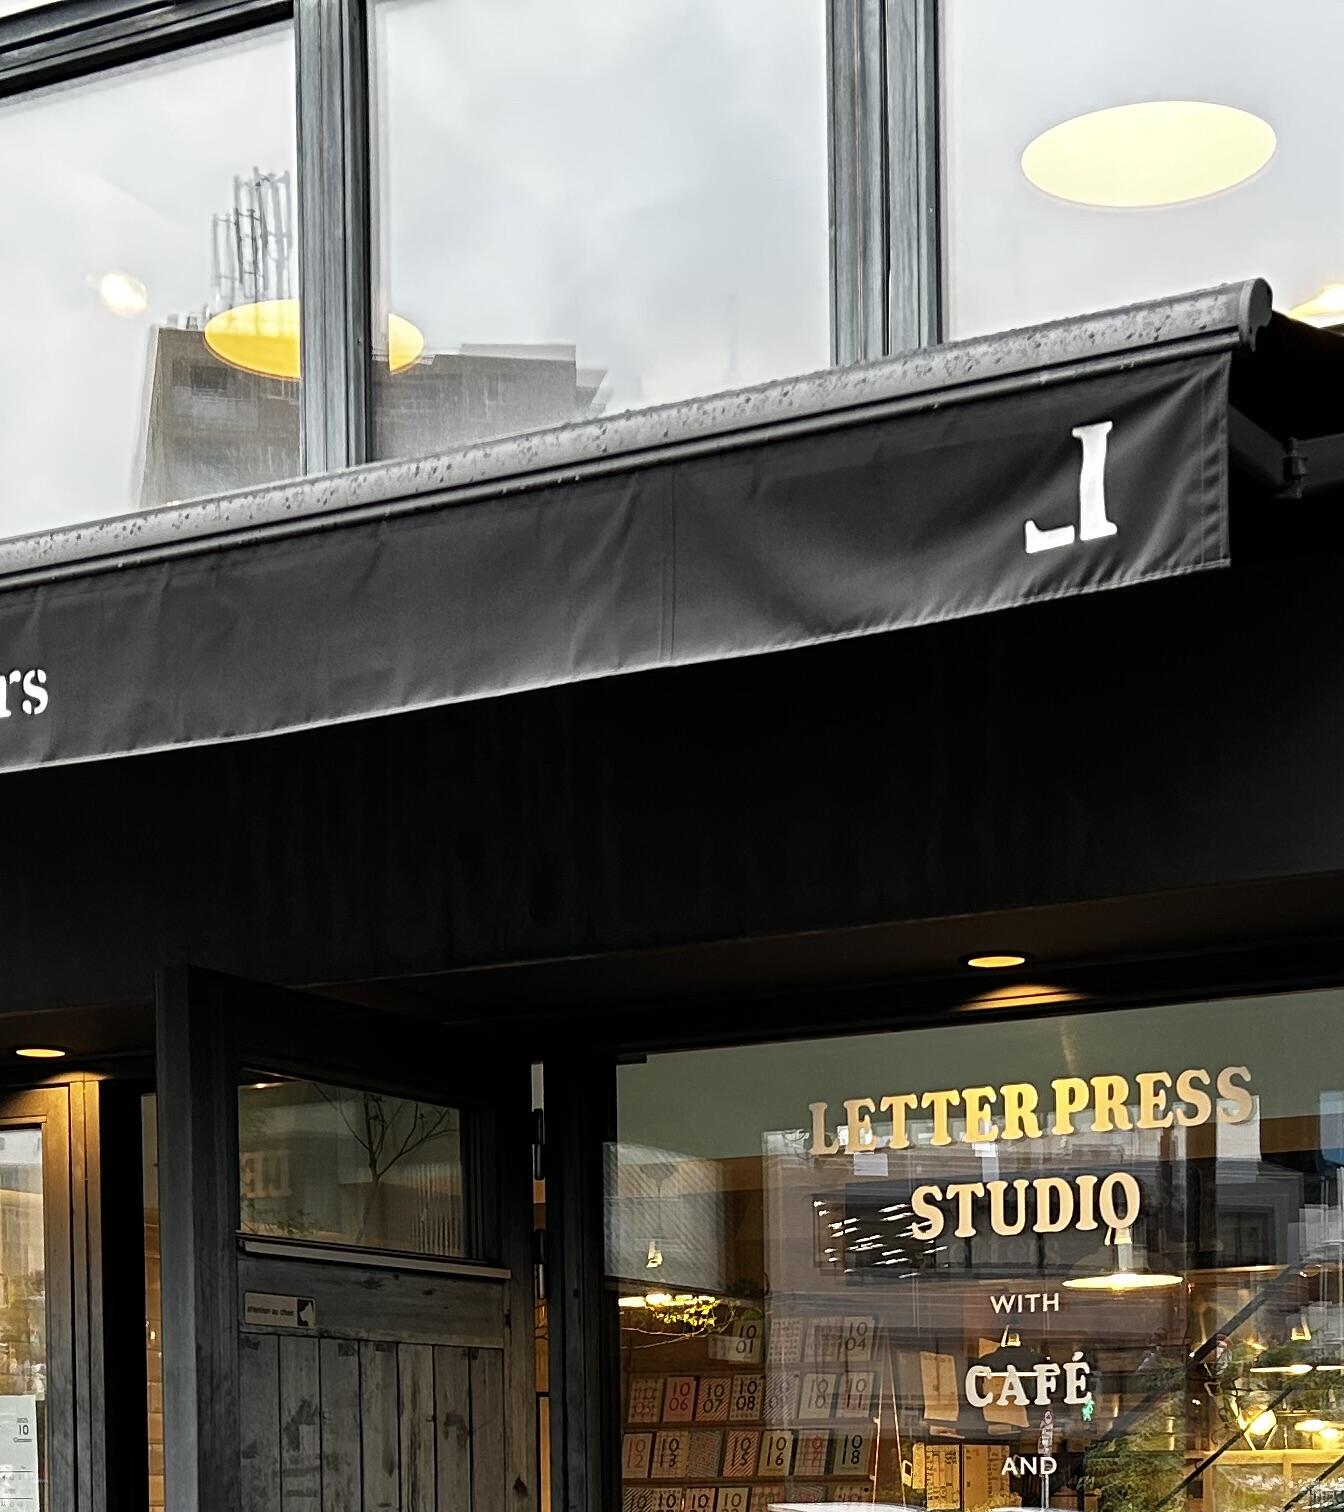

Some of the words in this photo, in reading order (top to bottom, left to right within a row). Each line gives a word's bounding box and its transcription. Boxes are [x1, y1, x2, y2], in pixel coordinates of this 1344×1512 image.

[910, 1171, 1141, 1241] STUDIO
[990, 1293, 1060, 1314] WITH
[739, 1324, 757, 1340] 10
[849, 1321, 868, 1337] 10
[736, 1339, 754, 1354] 01
[845, 1336, 866, 1352] 04
[739, 1379, 758, 1395] 10
[964, 1351, 1092, 1408] CAFÉ
[673, 1382, 691, 1397] 10
[707, 1383, 725, 1399] 10
[669, 1397, 688, 1411] 06
[703, 1398, 724, 1413] 07
[736, 1395, 755, 1411] 08
[661, 1438, 680, 1453] 10
[733, 1437, 752, 1452] 10
[769, 1436, 787, 1451] 10
[844, 1434, 863, 1449] 10
[660, 1453, 677, 1468] 13
[767, 1451, 784, 1467] 16
[842, 1449, 861, 1465] 18
[1001, 1456, 1057, 1476] AND
[658, 1493, 677, 1509] 10
[691, 1494, 709, 1509] 10
[724, 1493, 742, 1508] 10
